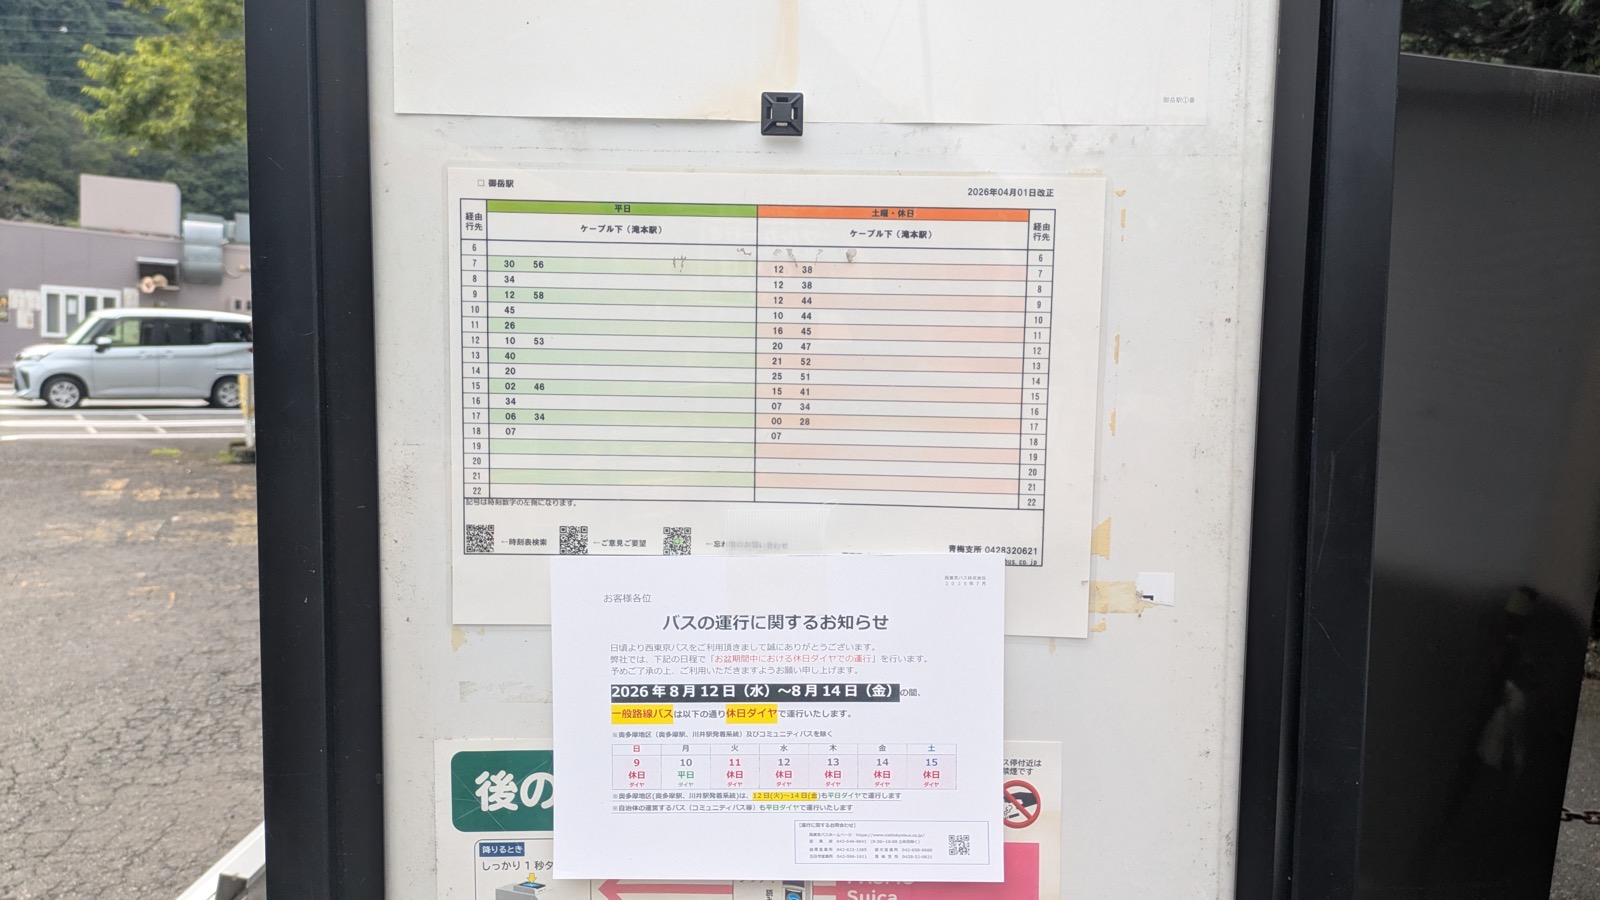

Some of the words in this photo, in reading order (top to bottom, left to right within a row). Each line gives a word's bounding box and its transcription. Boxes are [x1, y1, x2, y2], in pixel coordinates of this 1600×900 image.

[967, 188, 1054, 197] 2026年04月01日改正
[615, 204, 631, 213] 平日
[465, 212, 483, 221] 経由
[872, 209, 914, 217] 土曜・休日
[465, 222, 483, 231] 行先
[580, 225, 663, 234] ケーブル下（滝本駅）
[1033, 222, 1050, 231] 経由
[849, 229, 933, 239] ケーブル下（滝本駅）
[1033, 232, 1050, 241] 行先
[1039, 254, 1043, 262] 6
[774, 281, 783, 289] 12
[802, 281, 812, 289] 38
[1038, 285, 1042, 293] 8
[473, 290, 477, 298] 9
[774, 296, 783, 304] 12
[505, 306, 515, 314] 45
[1035, 316, 1043, 324] 10
[472, 336, 479, 344] 12
[534, 337, 544, 345] 53
[773, 342, 783, 350] 20
[772, 357, 781, 365] 21
[1033, 362, 1040, 370] 13
[505, 367, 515, 375] 20
[772, 372, 782, 380] 25
[505, 382, 515, 390] 02
[771, 417, 782, 425] 00
[771, 432, 781, 440] 07
[1030, 438, 1038, 446] 18
[473, 442, 481, 450] 19
[473, 457, 481, 465] 20
[1029, 453, 1037, 461] 19
[1029, 468, 1037, 476] 20
[1028, 483, 1035, 491] 21
[508, 538, 547, 546] 時刻表検索
[601, 539, 647, 548] ご意見ご要望
[949, 545, 982, 554] 青梅支所
[985, 546, 1038, 555] 0428320621
[603, 594, 652, 603] お客様各位
[662, 614, 889, 630] バスの運行に関するお知らせ
[611, 708, 852, 719] 一般路線バスは以下の通り休日ダイヤで運行いたします。
[633, 744, 640, 753] 日
[682, 744, 689, 752] 月
[730, 744, 739, 752] 火
[779, 758, 790, 766] 12
[828, 758, 839, 766] 13
[877, 758, 889, 766] 14
[629, 771, 645, 779] 休日
[678, 771, 694, 779] 平日
[776, 770, 792, 778] 休日
[825, 770, 841, 778] 休日
[482, 845, 522, 854] 降りるとき
[847, 889, 898, 900] Suica
